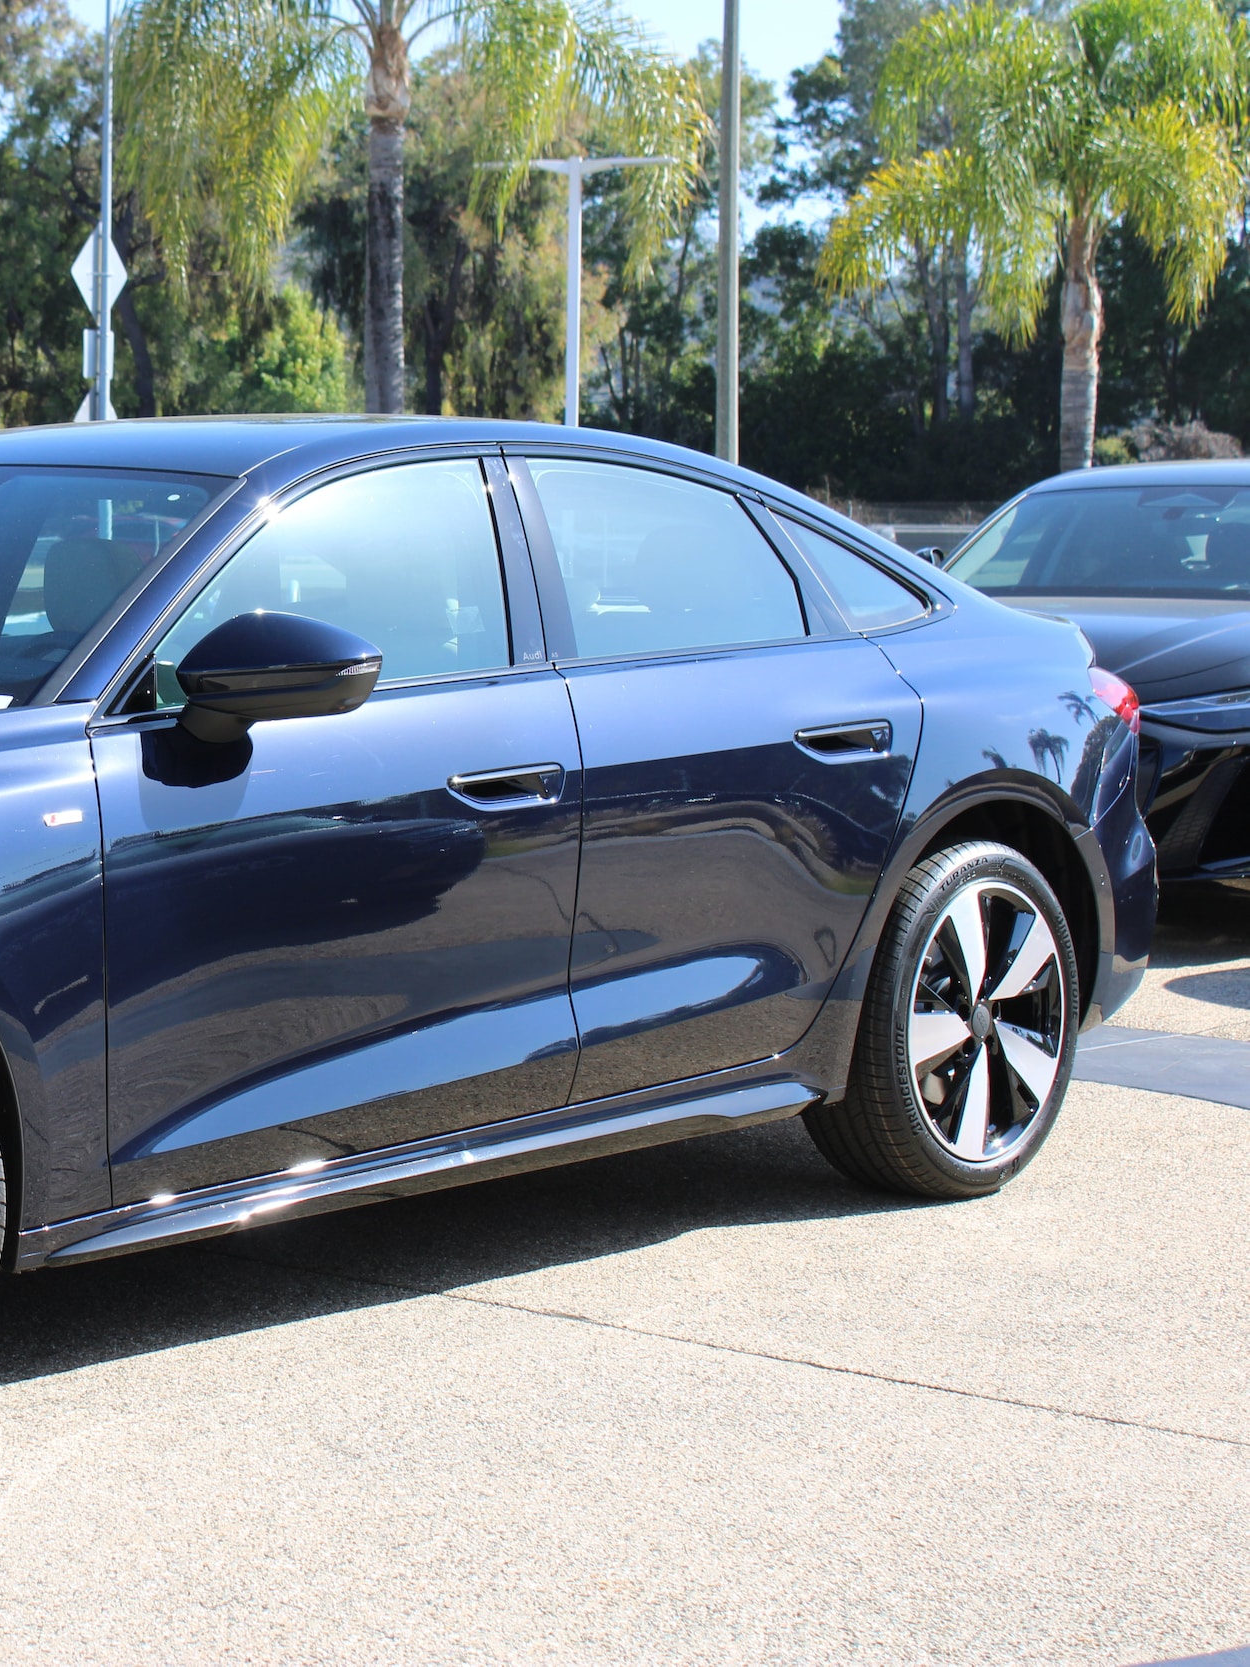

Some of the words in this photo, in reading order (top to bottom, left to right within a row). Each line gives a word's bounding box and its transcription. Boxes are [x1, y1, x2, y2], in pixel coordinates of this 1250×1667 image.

[523, 650, 543, 661] Audi
[938, 857, 989, 892] TURANZA
[895, 1022, 924, 1136] BRIDGESTONE
